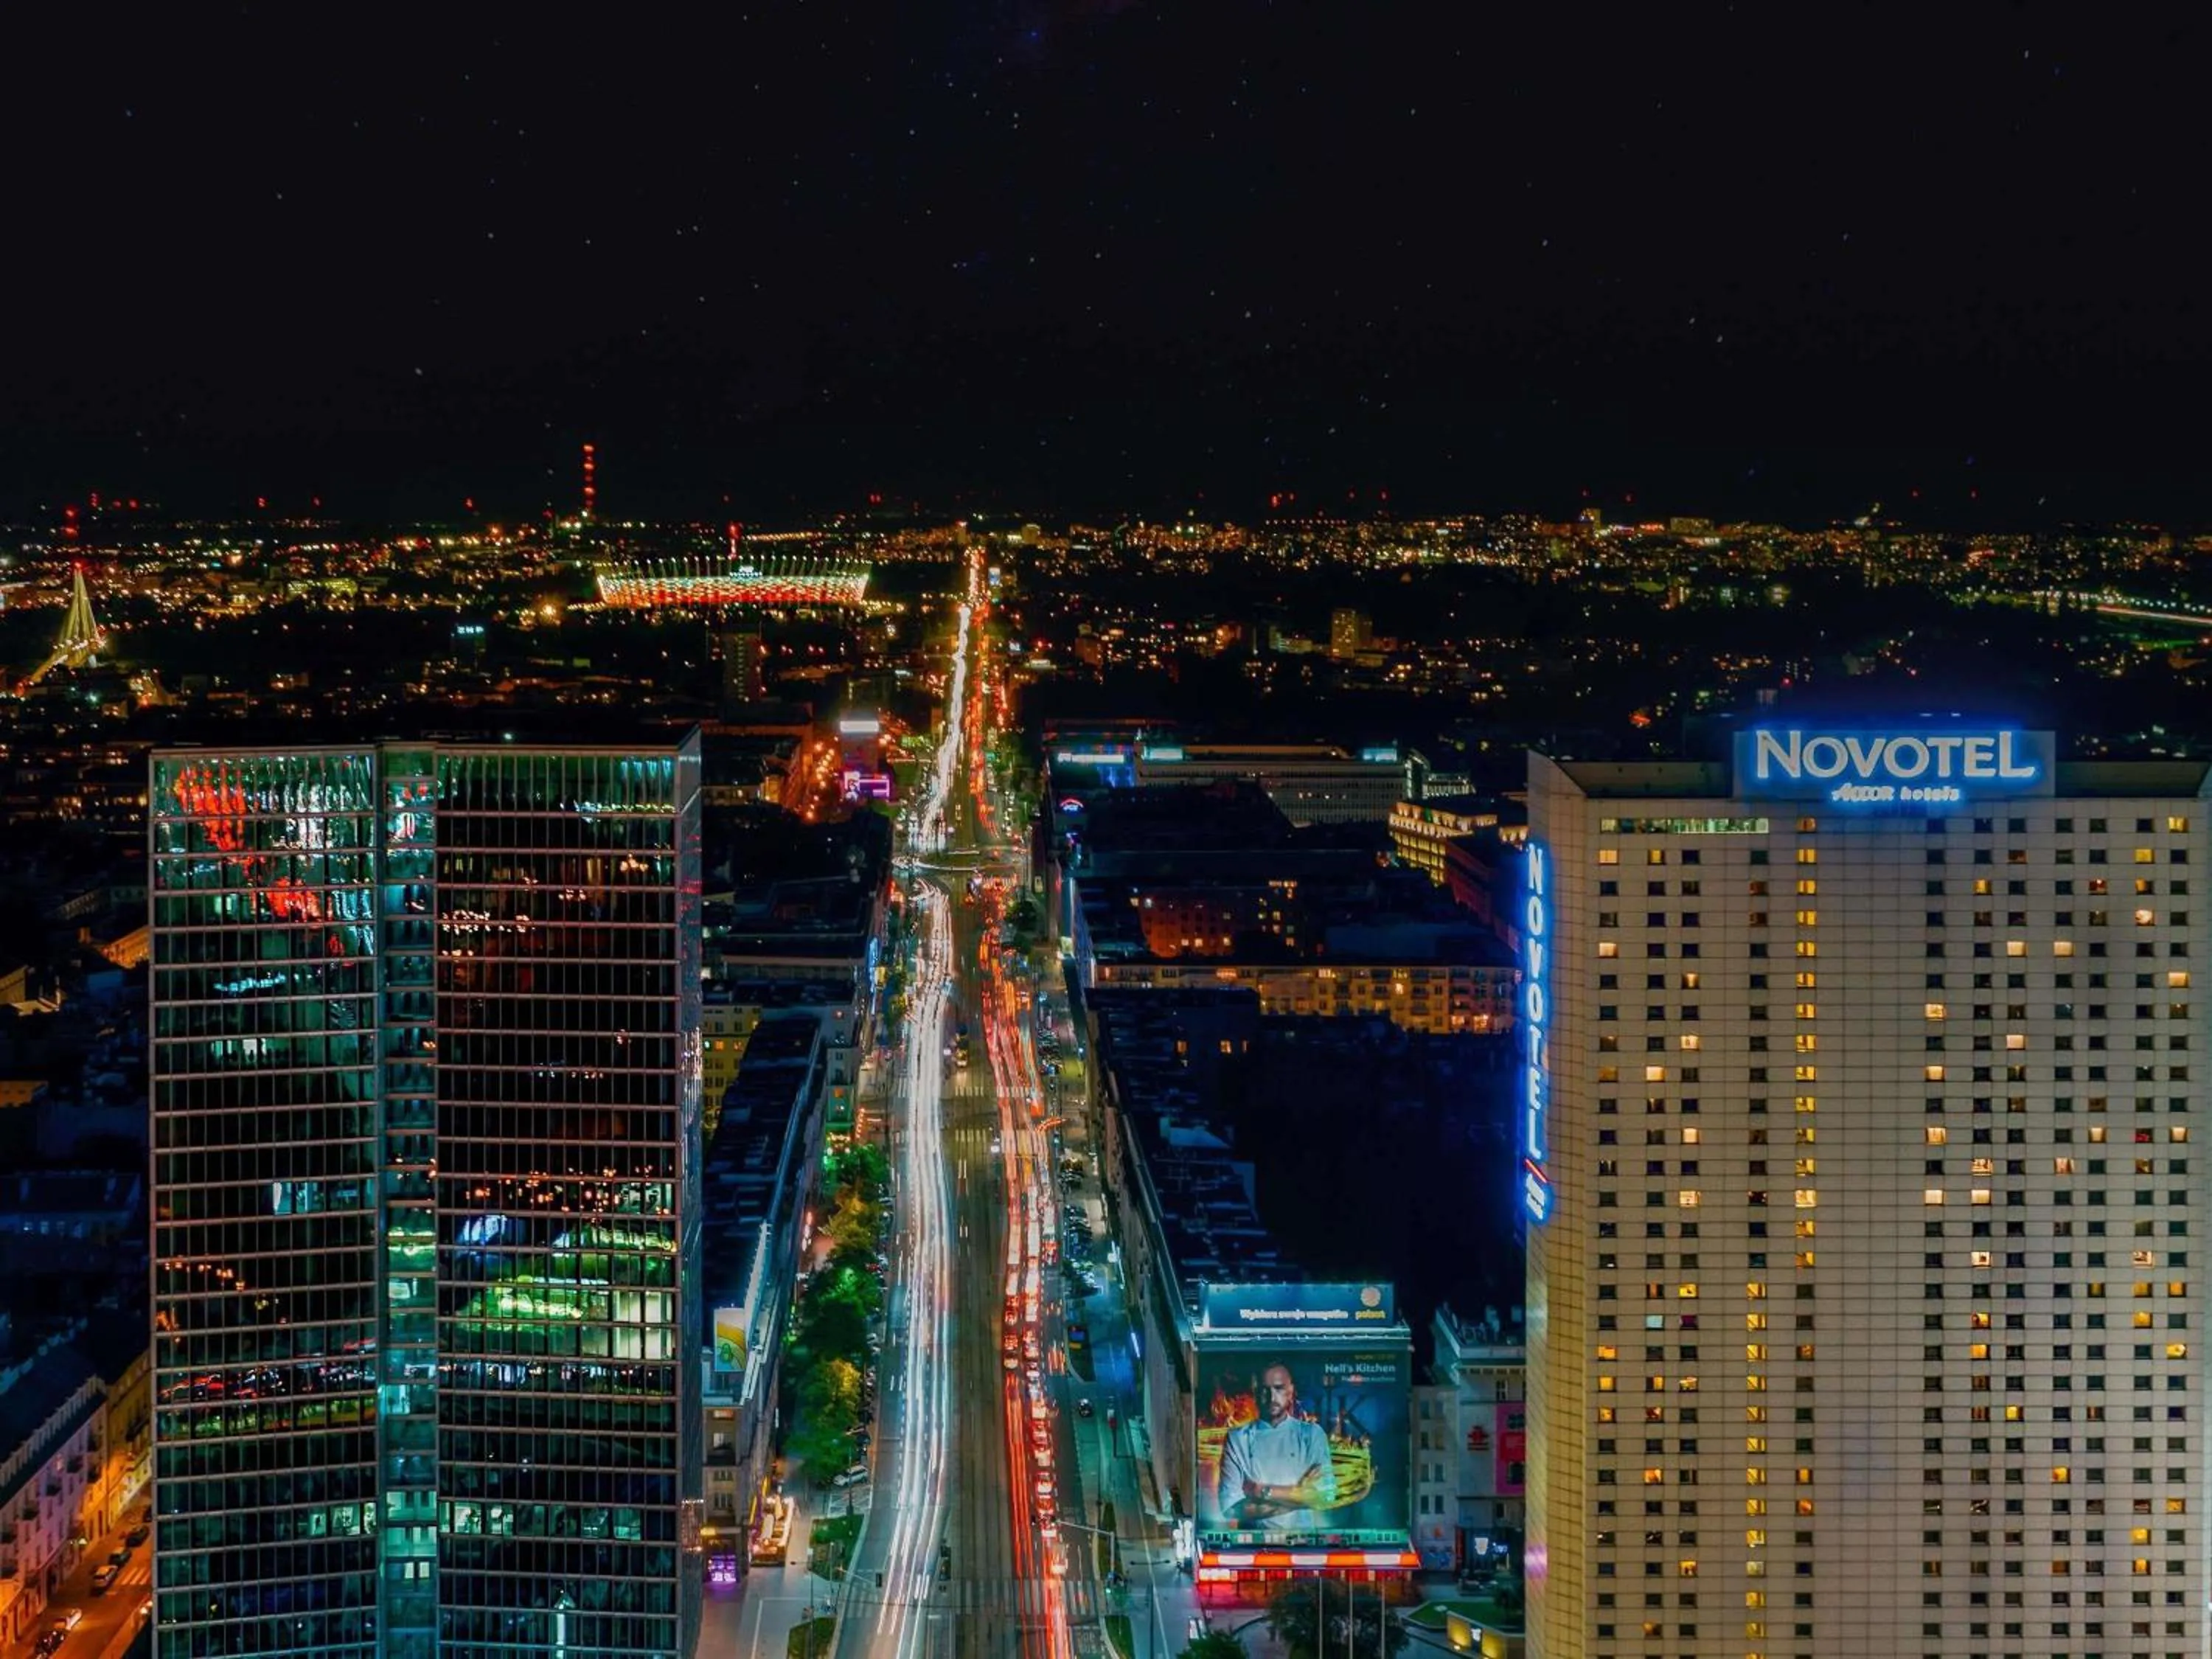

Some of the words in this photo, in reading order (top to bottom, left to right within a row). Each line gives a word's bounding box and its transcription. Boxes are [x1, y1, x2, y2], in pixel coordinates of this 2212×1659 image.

[1756, 731, 2036, 778] NOVOTEL
[1527, 843, 1545, 1160] NOVOTEL
[1356, 1362, 1396, 1373] Kitchen
